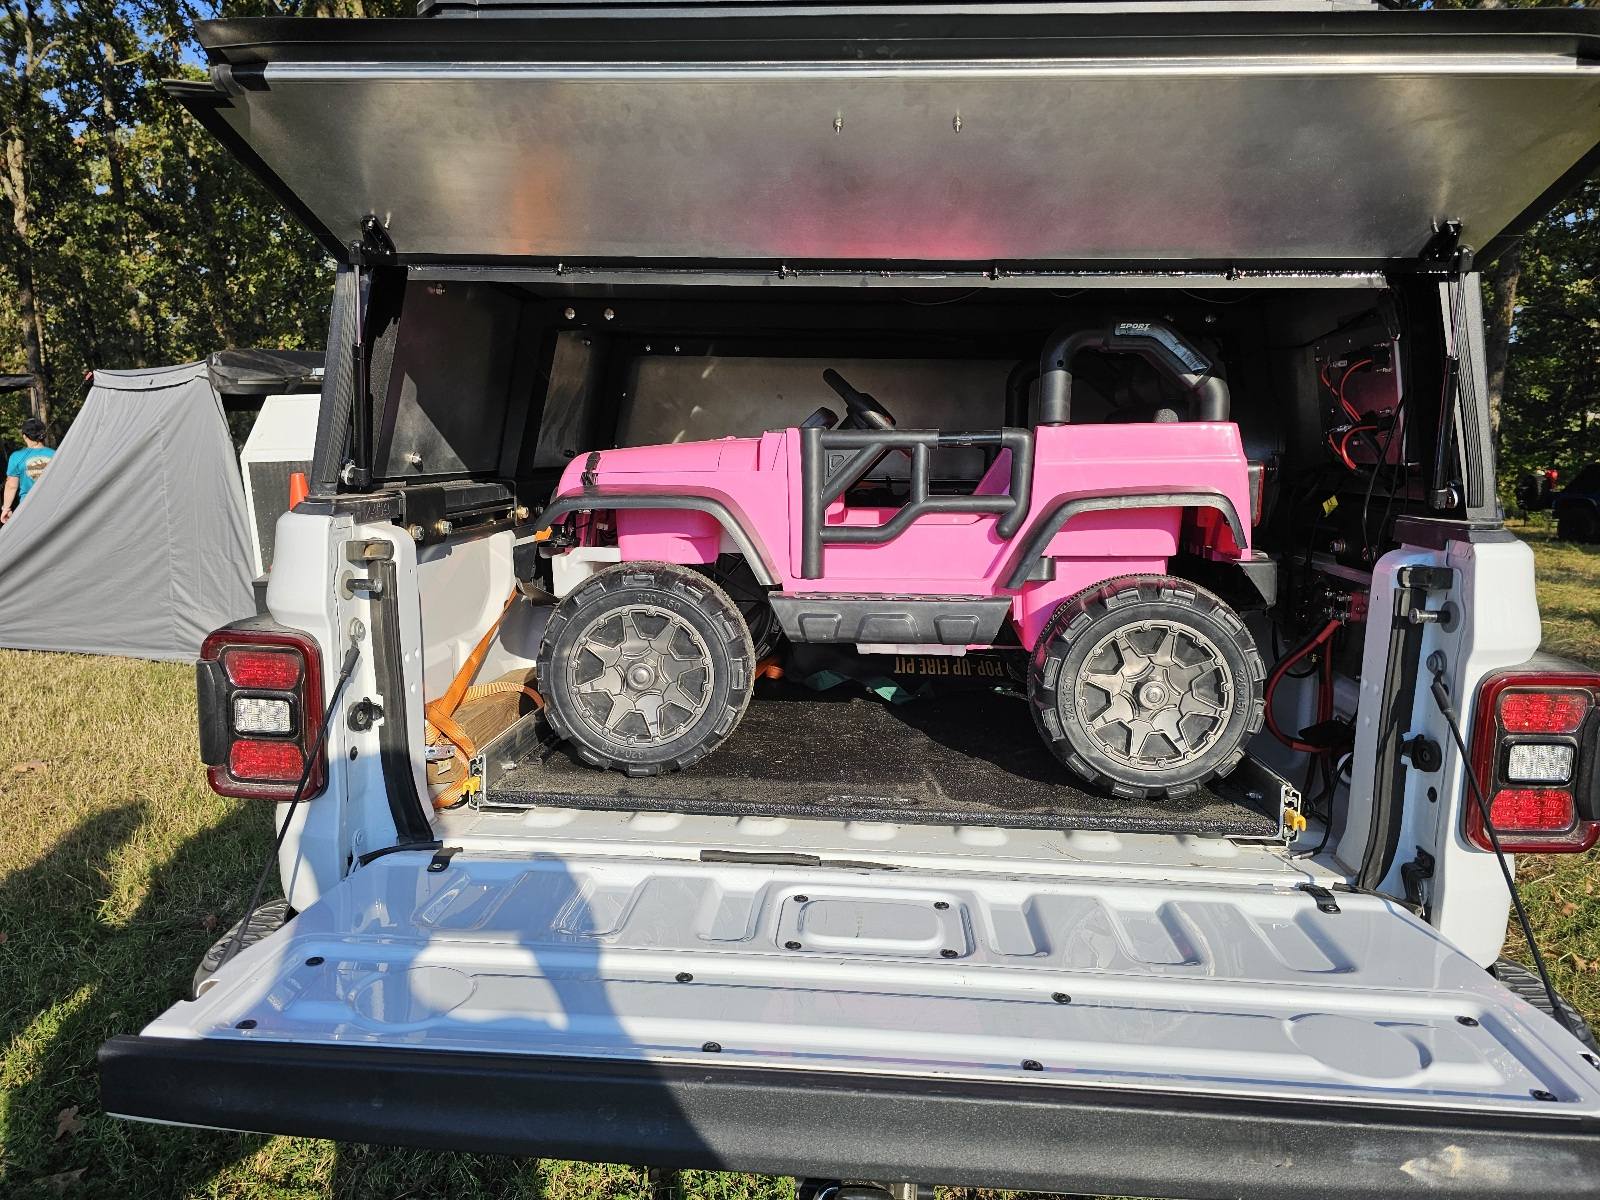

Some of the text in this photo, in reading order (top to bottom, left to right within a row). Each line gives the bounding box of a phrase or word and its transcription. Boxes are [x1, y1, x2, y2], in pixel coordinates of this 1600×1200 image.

[1120, 323, 1151, 331] SPORT
[894, 656, 1004, 677] POP-UP FIRE PIT
